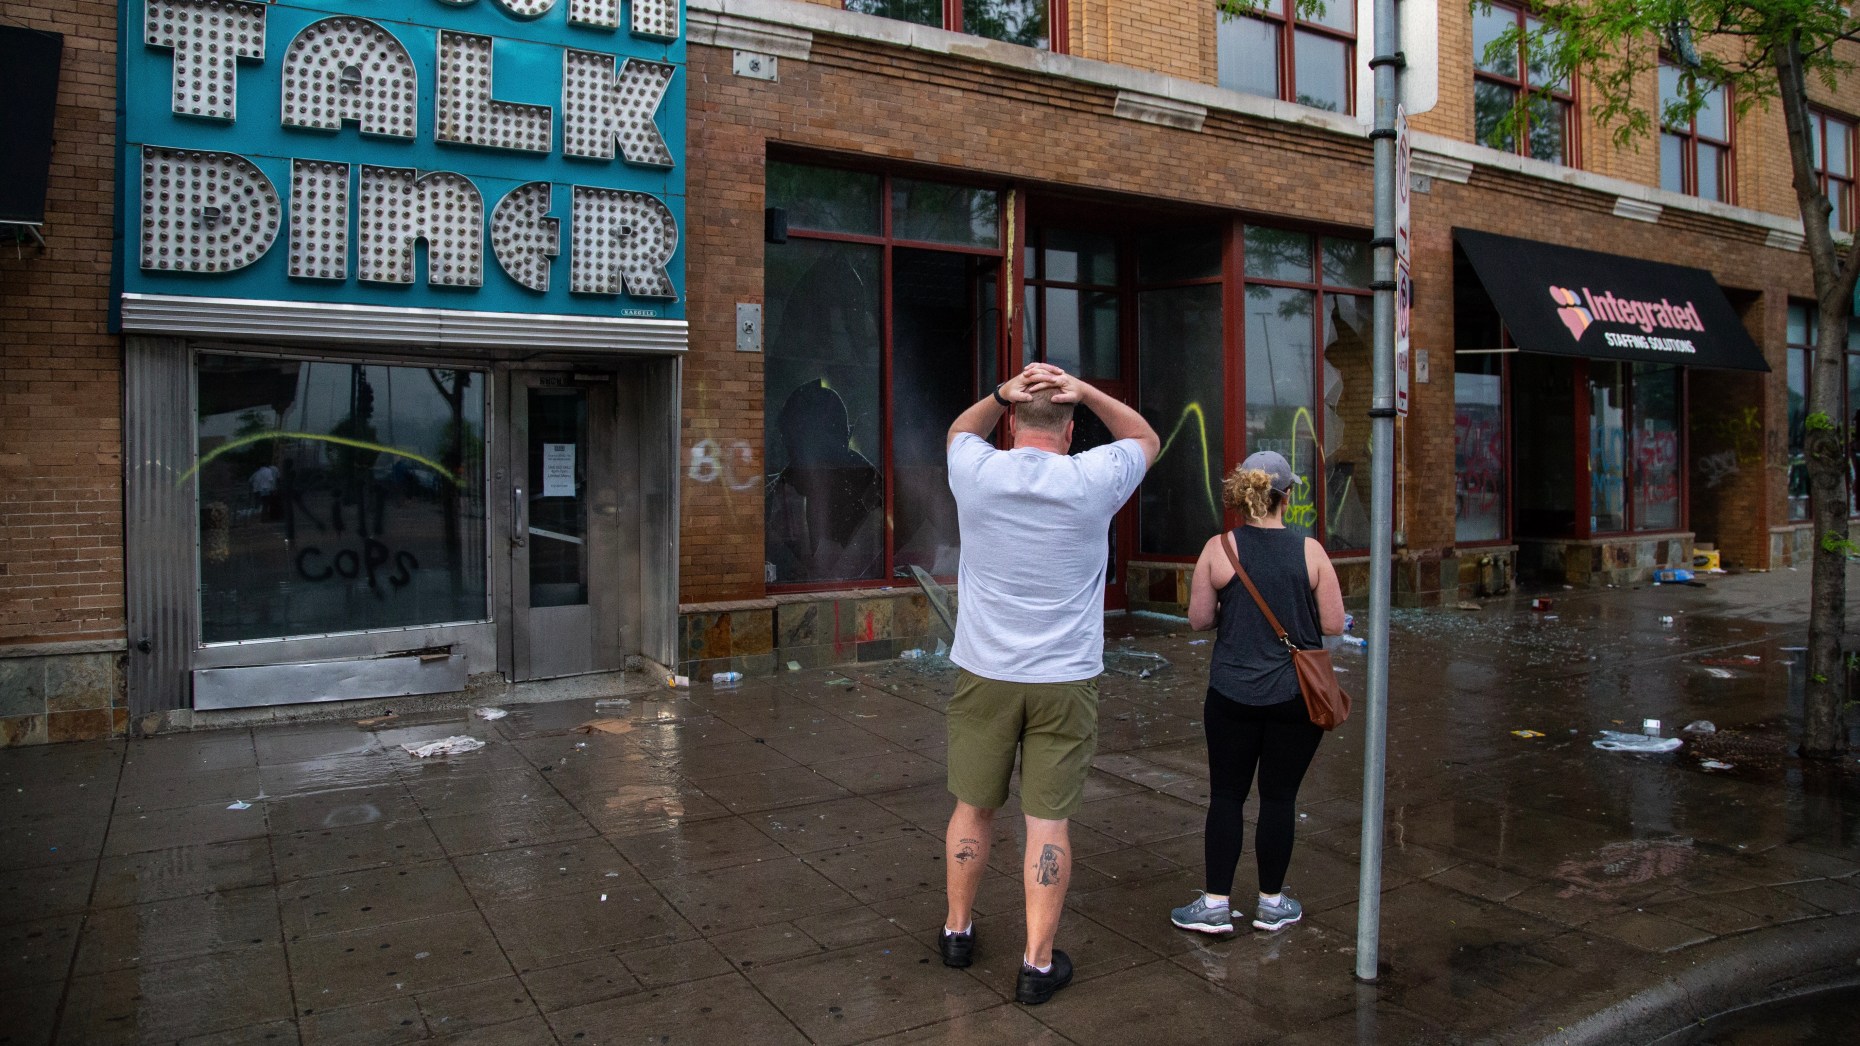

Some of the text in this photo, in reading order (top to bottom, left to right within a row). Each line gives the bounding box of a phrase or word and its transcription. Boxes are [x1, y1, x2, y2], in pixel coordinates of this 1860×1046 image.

[144, 0, 677, 168] TALK
[139, 144, 680, 303] DINER
[1581, 287, 1705, 334] Integrated
[1604, 332, 1696, 353] STAFFING SOLUTIONS
